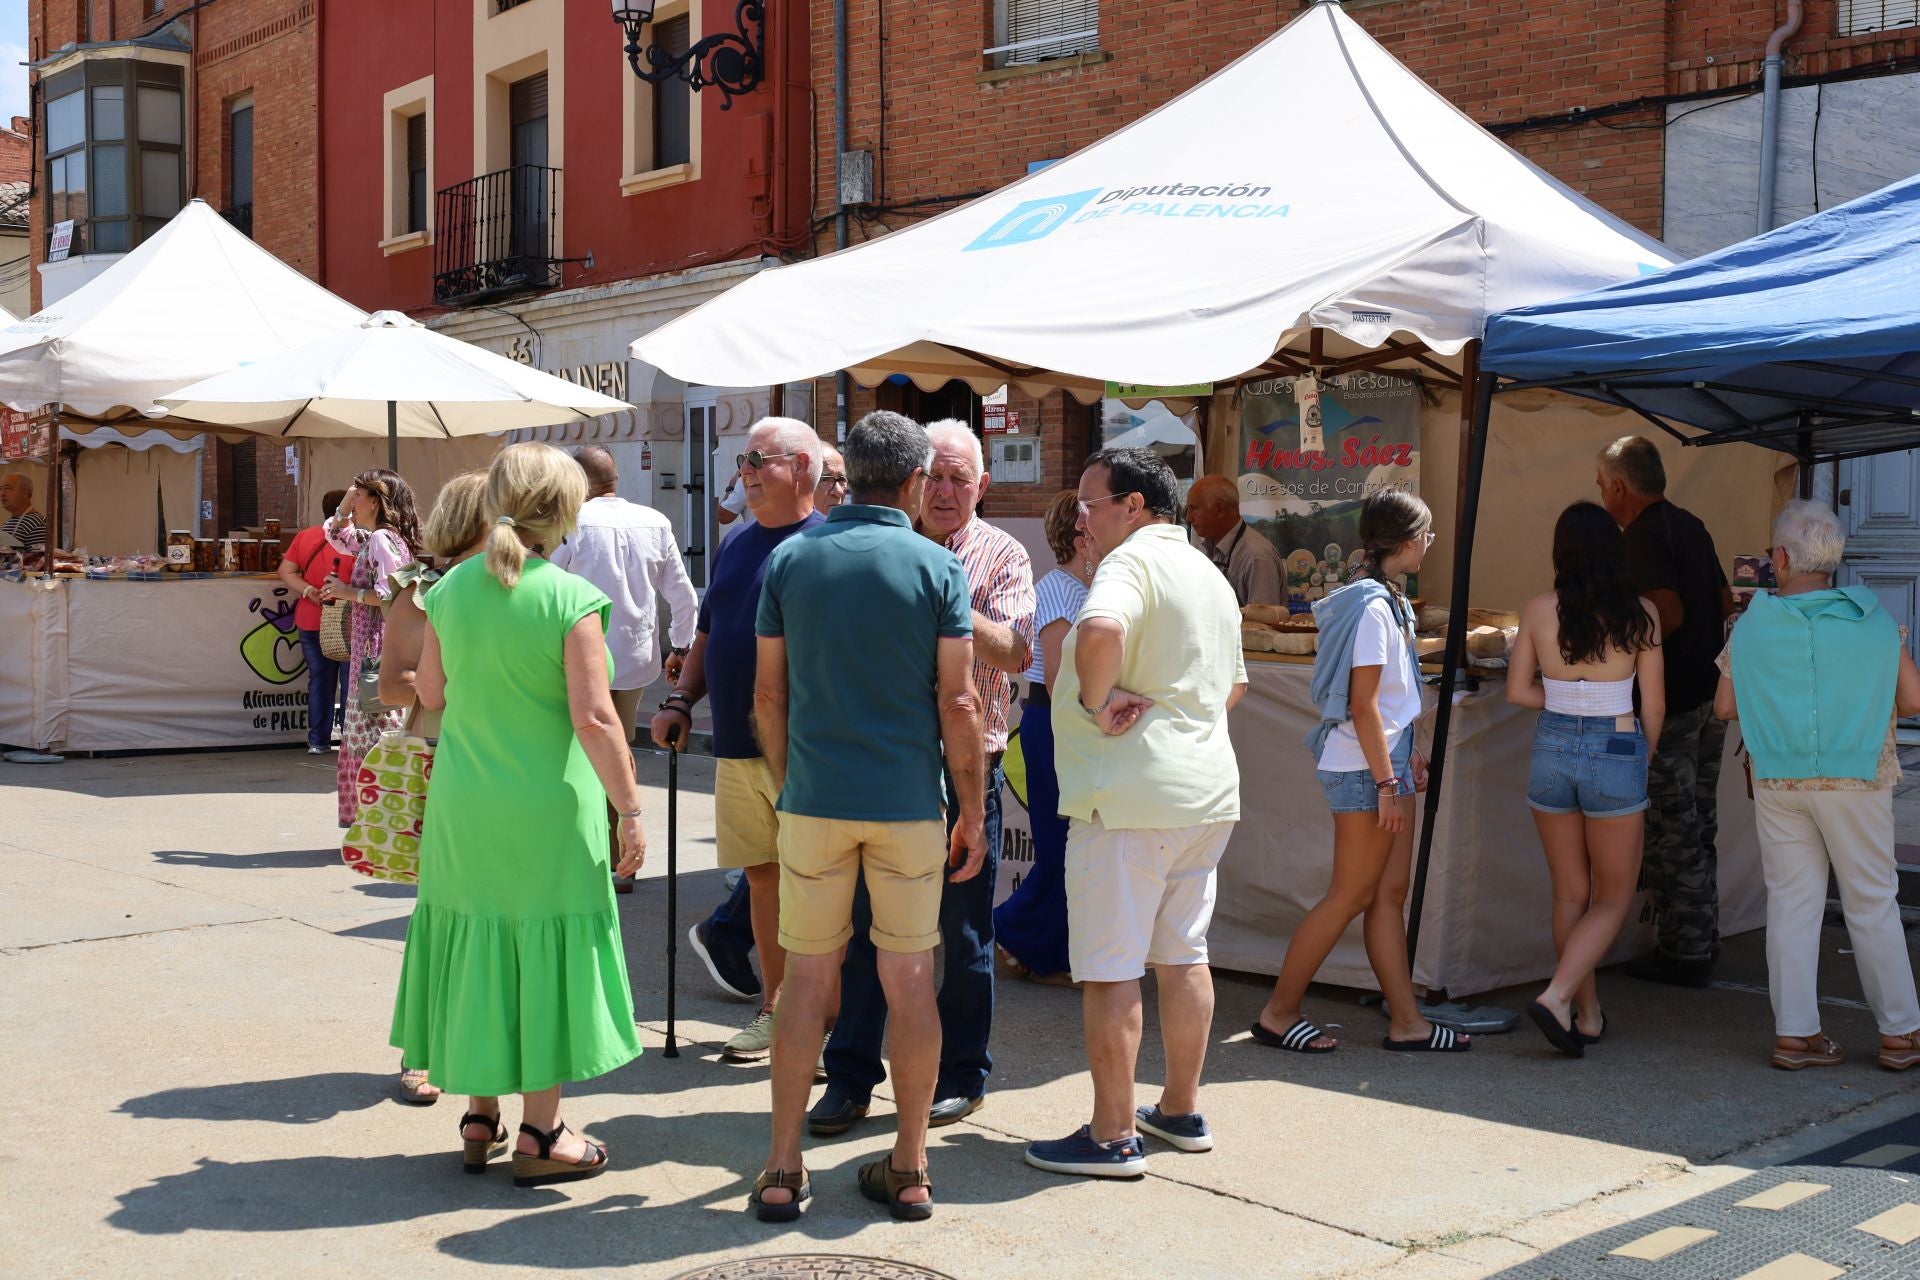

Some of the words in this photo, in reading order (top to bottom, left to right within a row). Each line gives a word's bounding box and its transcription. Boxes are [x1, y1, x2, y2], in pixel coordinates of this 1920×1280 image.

[1096, 182, 1272, 205] Diputación
[1072, 205, 1121, 224] DE
[1119, 202, 1291, 219] PALENCIA
[1352, 314, 1391, 324] MASTERTENT
[1244, 438, 1336, 473] Hnos.
[1340, 433, 1413, 469] Sáez
[1246, 479, 1304, 496] Quesos
[1309, 477, 1330, 495] de
[243, 690, 310, 709] Alimento
[253, 714, 268, 729] de
